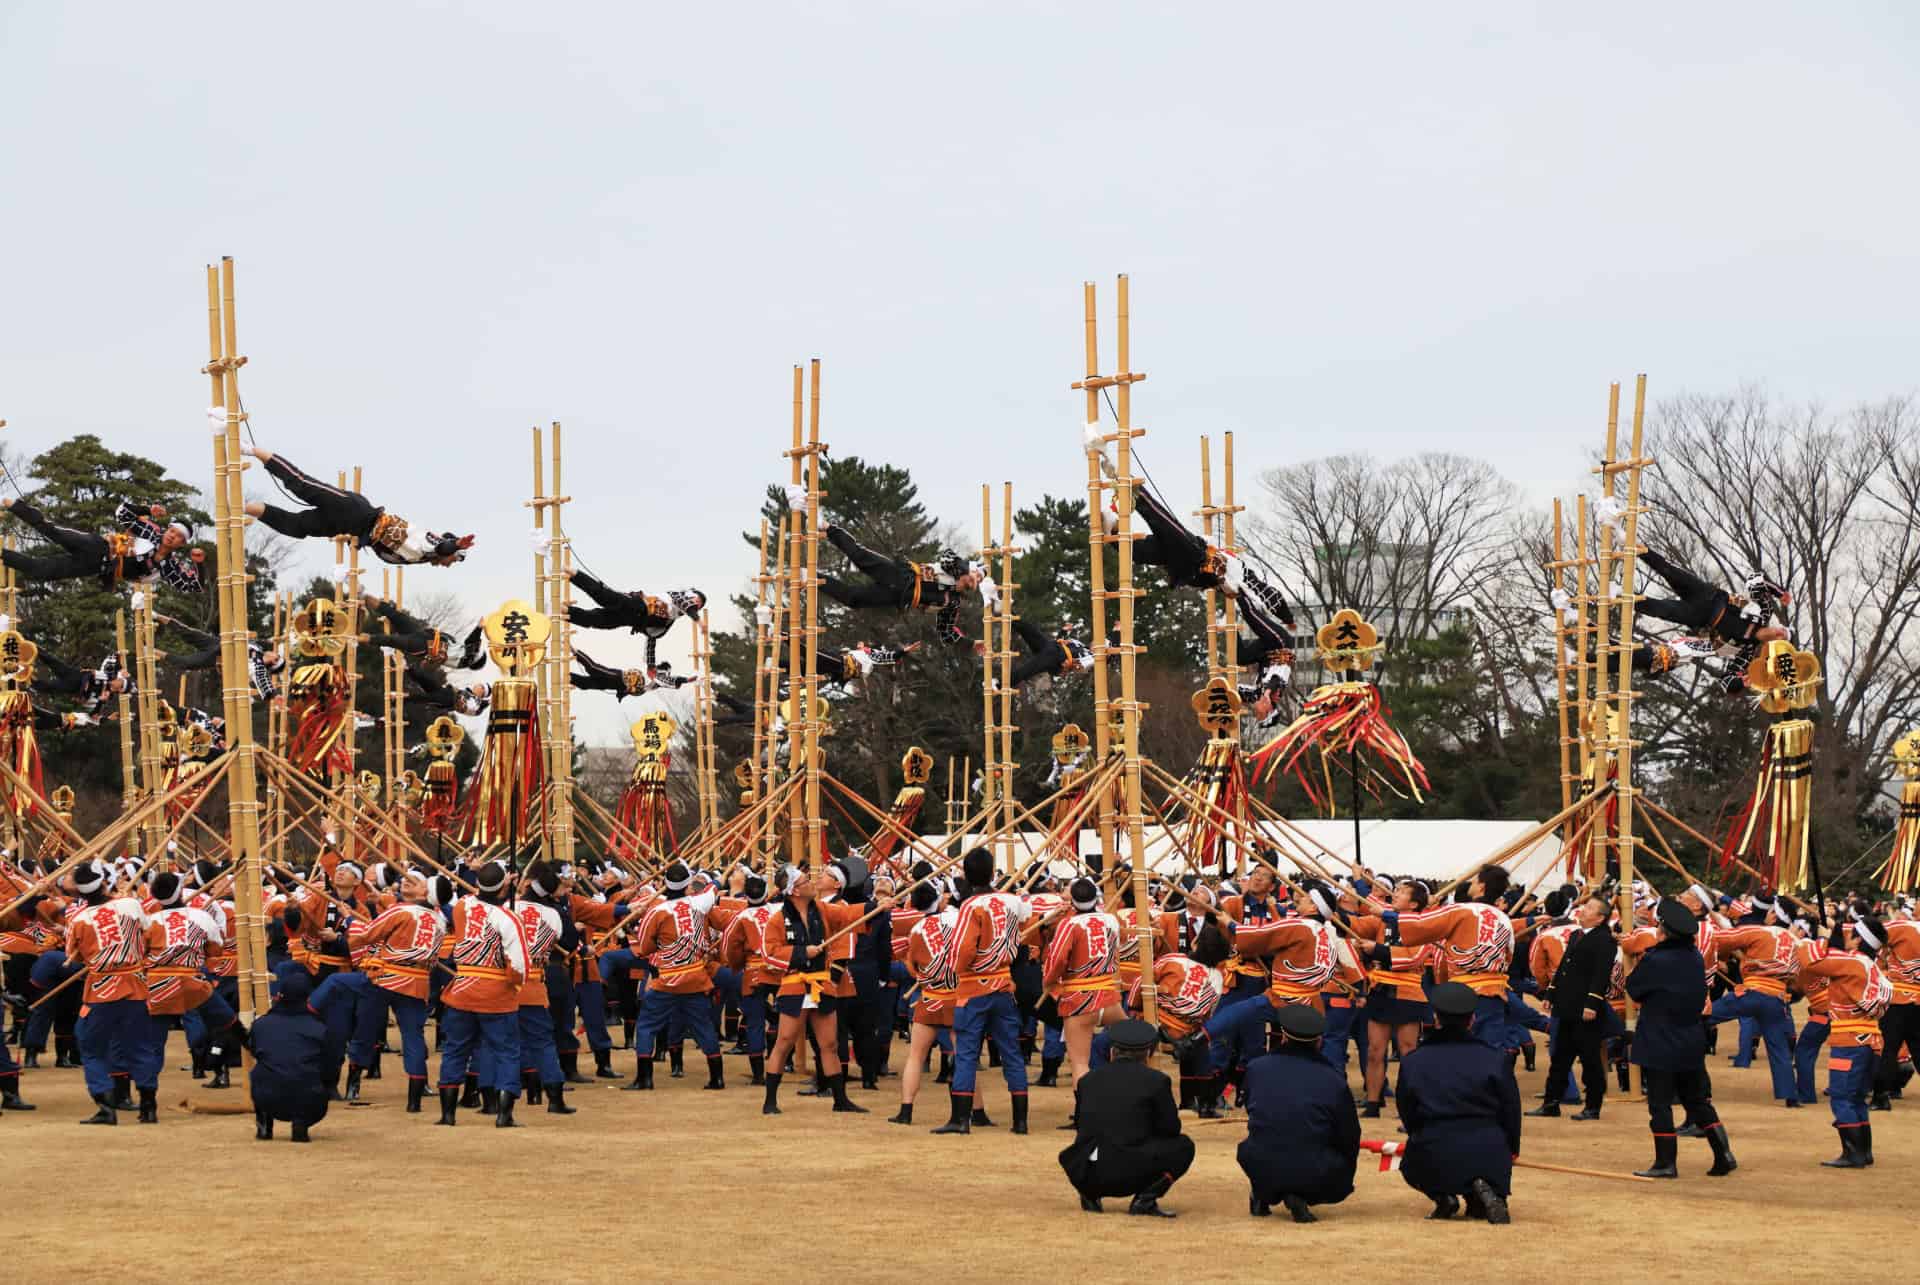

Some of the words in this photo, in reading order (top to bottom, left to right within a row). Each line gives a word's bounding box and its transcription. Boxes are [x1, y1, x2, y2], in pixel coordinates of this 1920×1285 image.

[93, 906, 124, 948] 金沢
[166, 911, 188, 946] 金沢
[415, 911, 437, 948] 金沢
[468, 904, 487, 940] 金沢
[673, 901, 693, 936] 金沢
[923, 916, 945, 956] 金沢
[1087, 917, 1107, 956] 金沢
[1479, 908, 1497, 945] 金沢
[1317, 928, 1331, 967] 金沢
[1181, 964, 1209, 1000] 金沢
